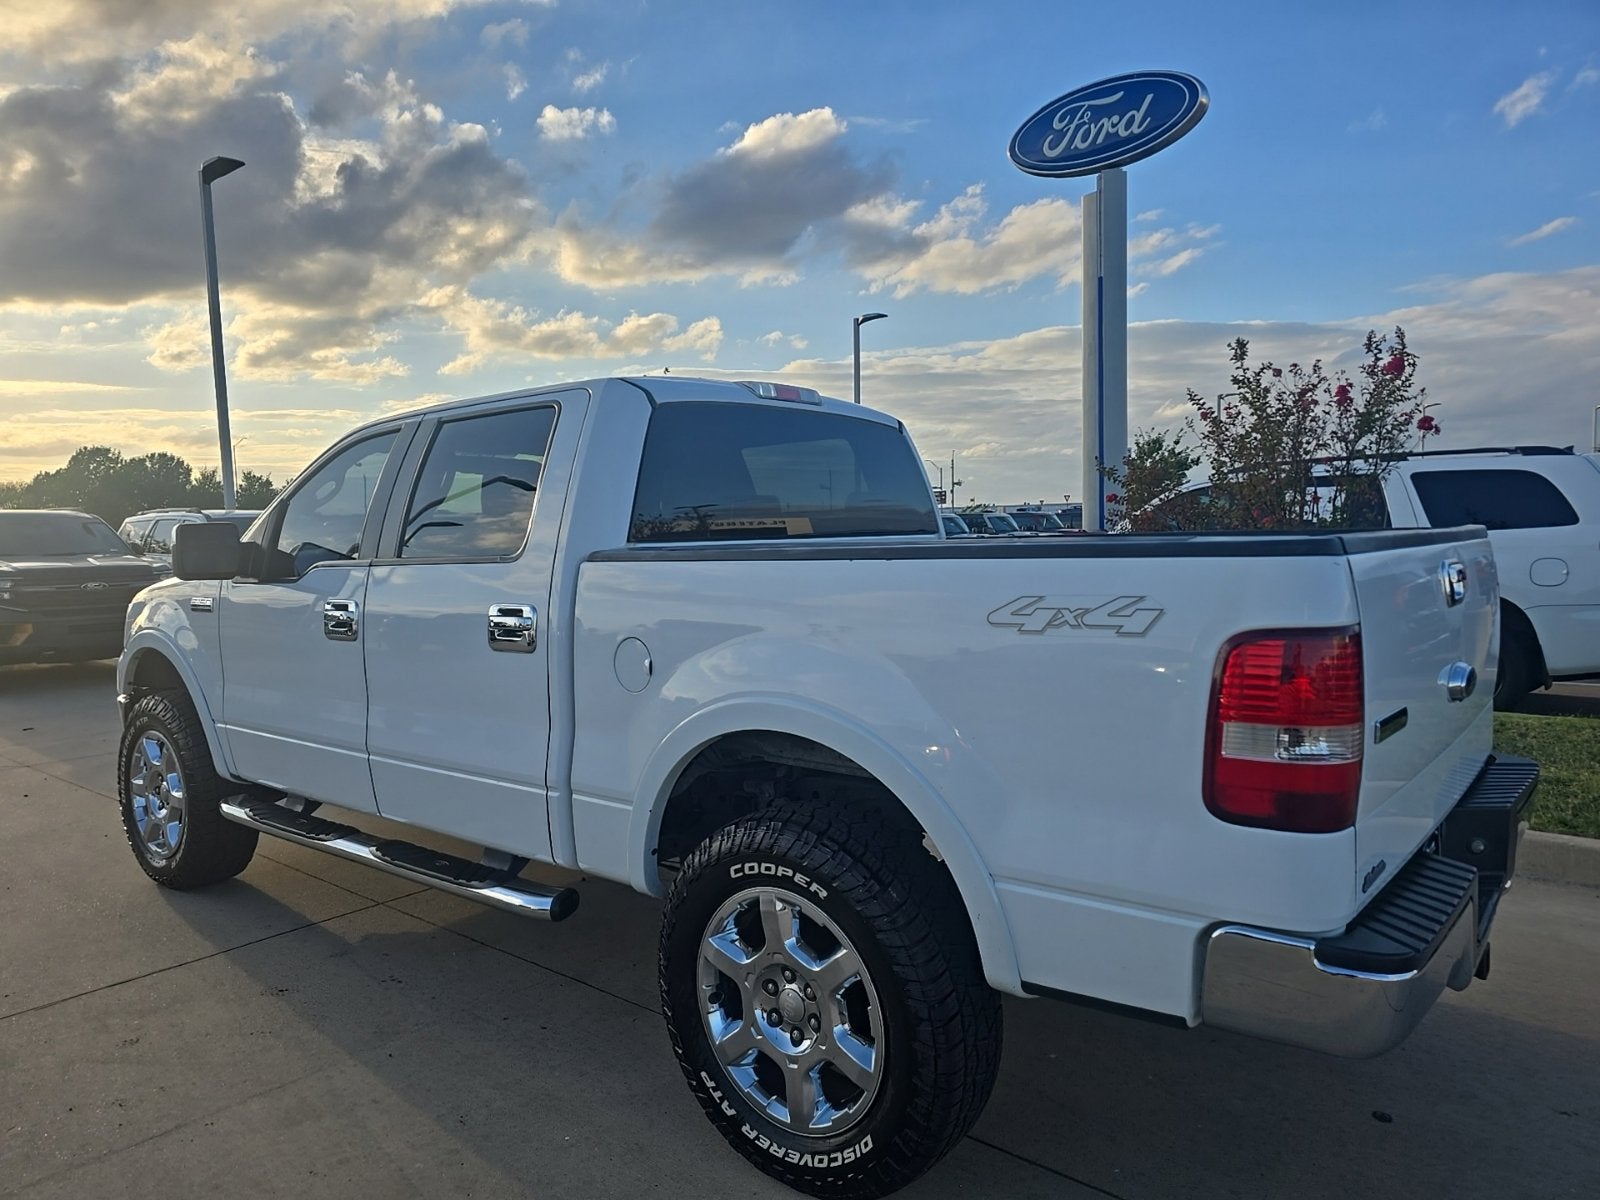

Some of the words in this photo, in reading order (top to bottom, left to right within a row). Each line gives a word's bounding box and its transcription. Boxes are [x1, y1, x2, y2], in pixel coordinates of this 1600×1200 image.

[1042, 90, 1154, 157] Ford
[730, 862, 828, 900] COOPER
[700, 1071, 737, 1117] ATP
[741, 1122, 874, 1168] DISCOVERER
